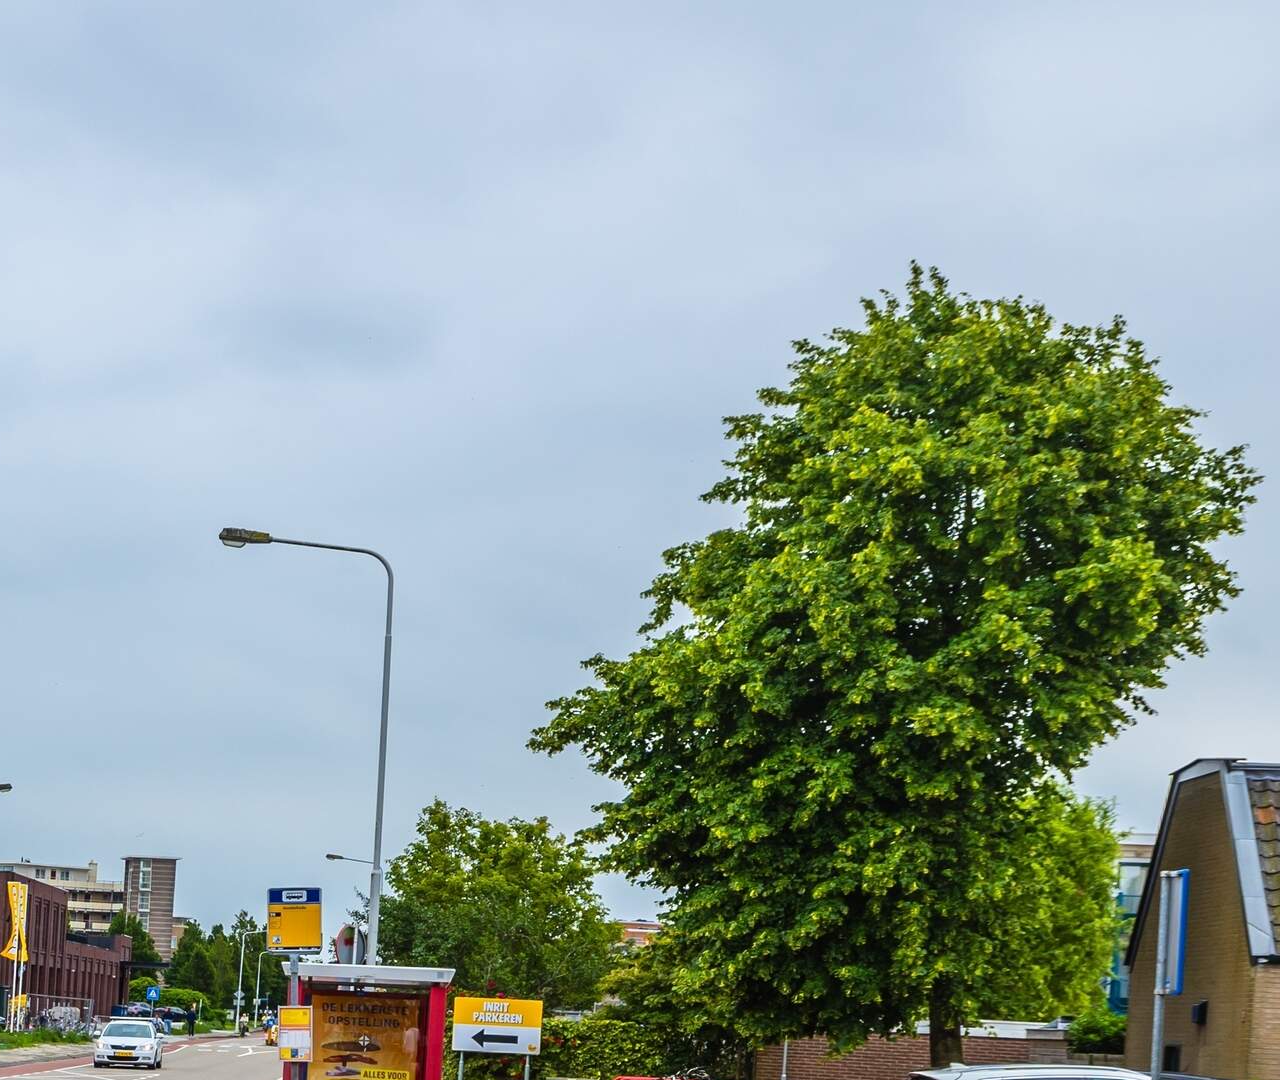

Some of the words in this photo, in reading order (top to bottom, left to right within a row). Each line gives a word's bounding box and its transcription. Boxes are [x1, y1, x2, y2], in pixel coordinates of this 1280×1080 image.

[322, 1002, 337, 1012] DE
[340, 1003, 409, 1016] LEKKERSTE
[483, 1001, 510, 1013] INRIT
[328, 1015, 400, 1029] OPSTELLING
[472, 1012, 524, 1024] PARKEREN
[362, 1070, 386, 1079] ALLES
[387, 1071, 408, 1080] VOOR
